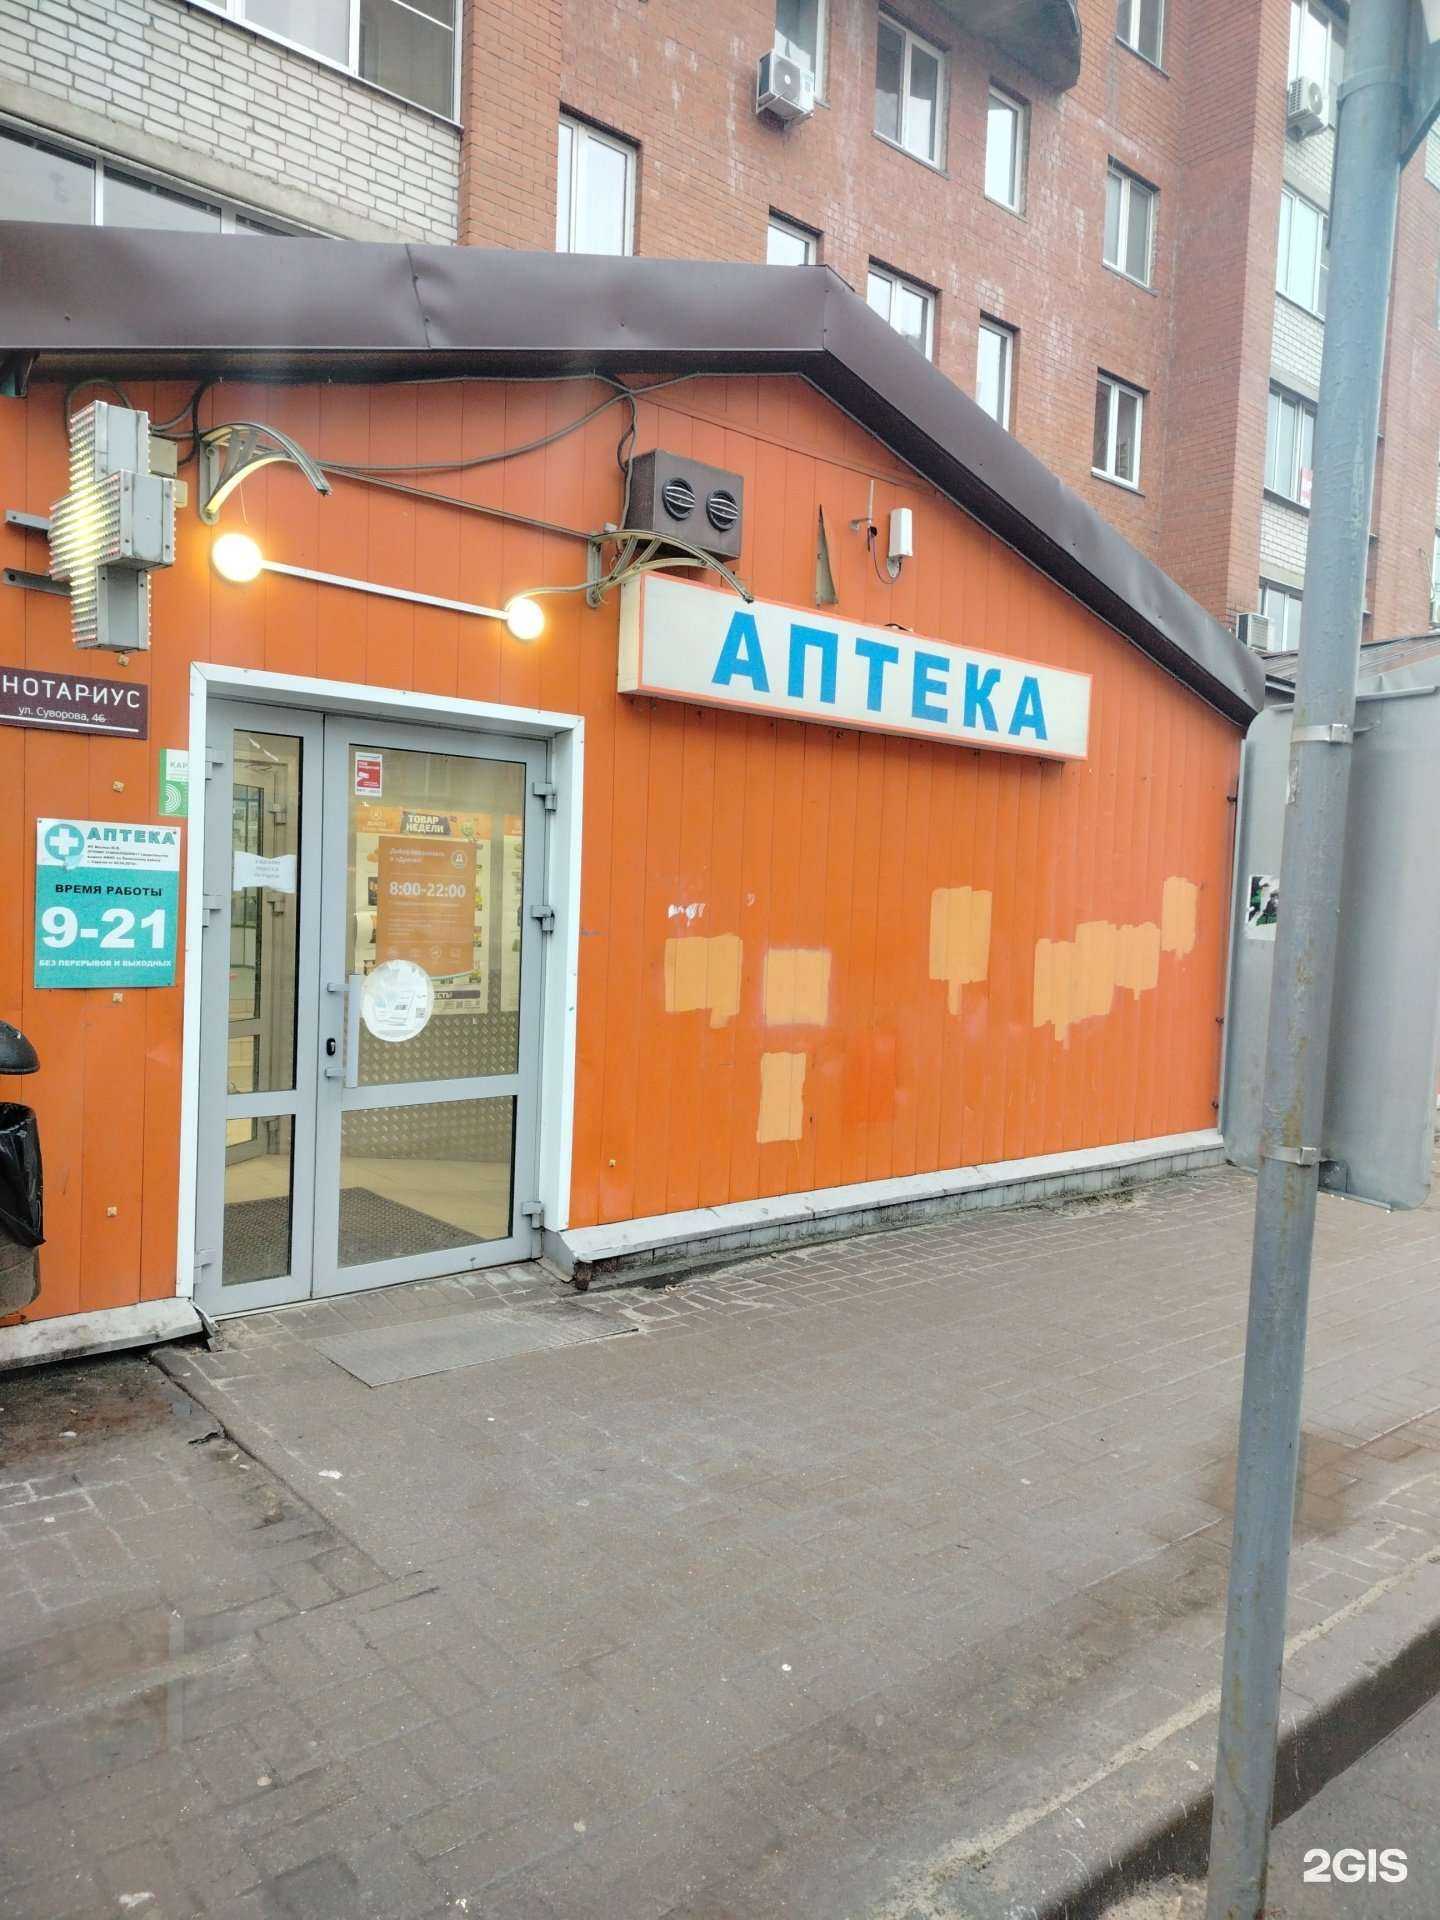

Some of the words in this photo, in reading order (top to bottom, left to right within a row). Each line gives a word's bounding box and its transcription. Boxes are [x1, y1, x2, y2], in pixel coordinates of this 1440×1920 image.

[711, 611, 1048, 741] АПТЕКА
[2, 674, 140, 708] НОТАРИУС
[18, 706, 33, 716] ул.
[36, 706, 89, 722] Суворова,
[407, 814, 440, 825] ТОВАР
[87, 826, 176, 845] АПТЕКА
[406, 823, 445, 834] НЕДЕЛИ
[55, 884, 102, 894] ВРЕМЯ
[106, 886, 162, 897] РАБОТЫ
[389, 881, 466, 898] 8:00-22:00
[41, 906, 166, 949] 9-21
